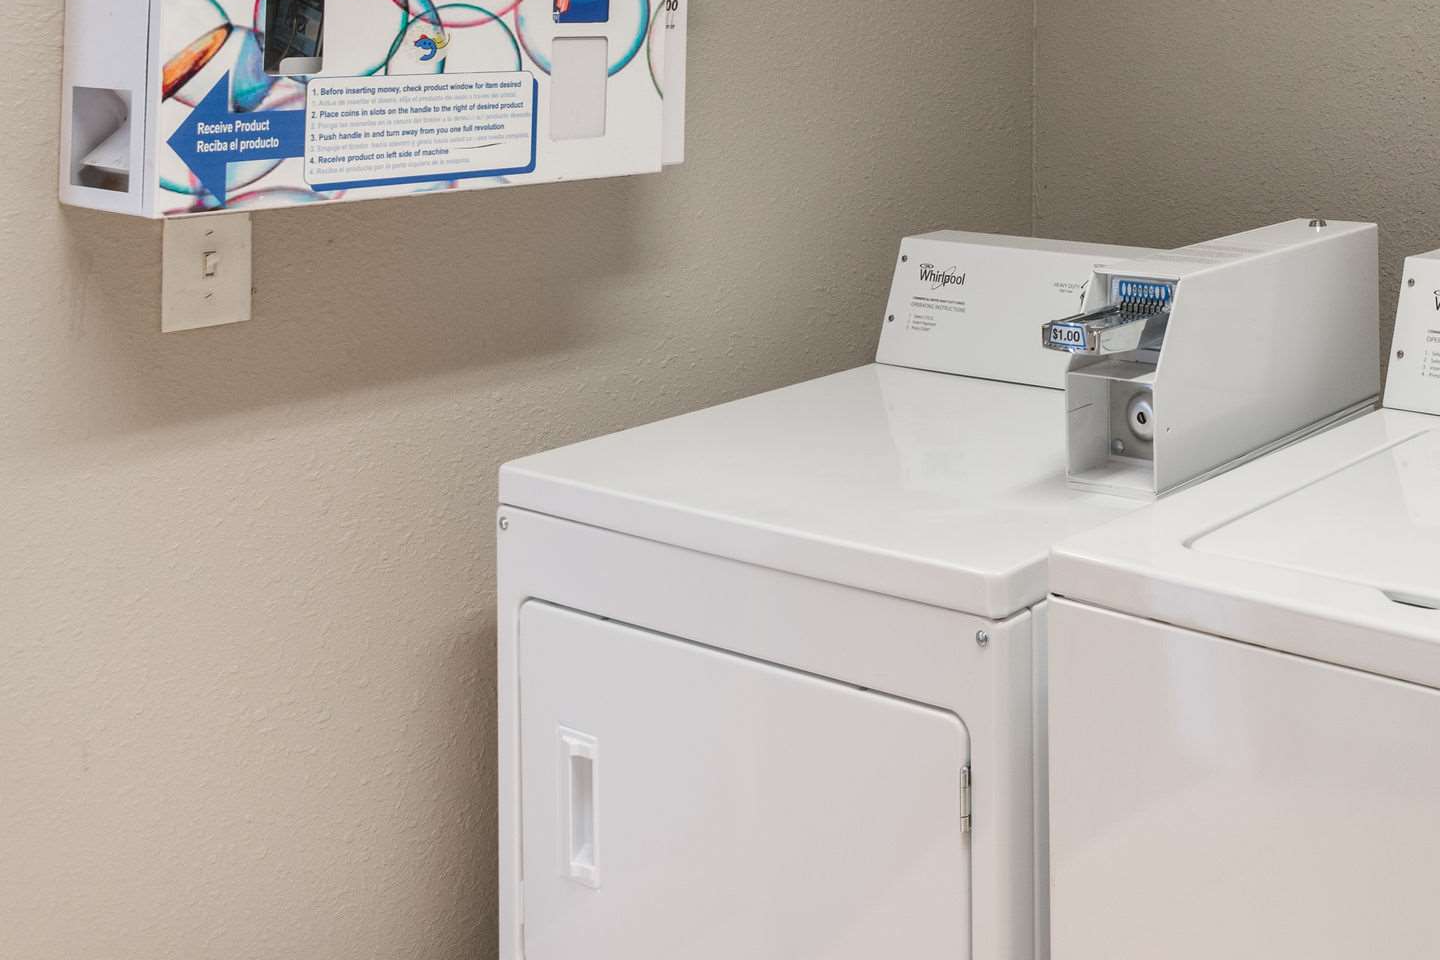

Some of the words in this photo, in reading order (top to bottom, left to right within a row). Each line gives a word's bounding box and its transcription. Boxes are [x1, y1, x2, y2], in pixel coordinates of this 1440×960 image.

[197, 122, 233, 134] Receive
[235, 120, 270, 131] Product
[197, 140, 228, 152] Reciba
[230, 139, 238, 150] el
[240, 138, 279, 152] producto
[920, 269, 966, 287] Whirlpool
[1052, 327, 1080, 343] $1.00
